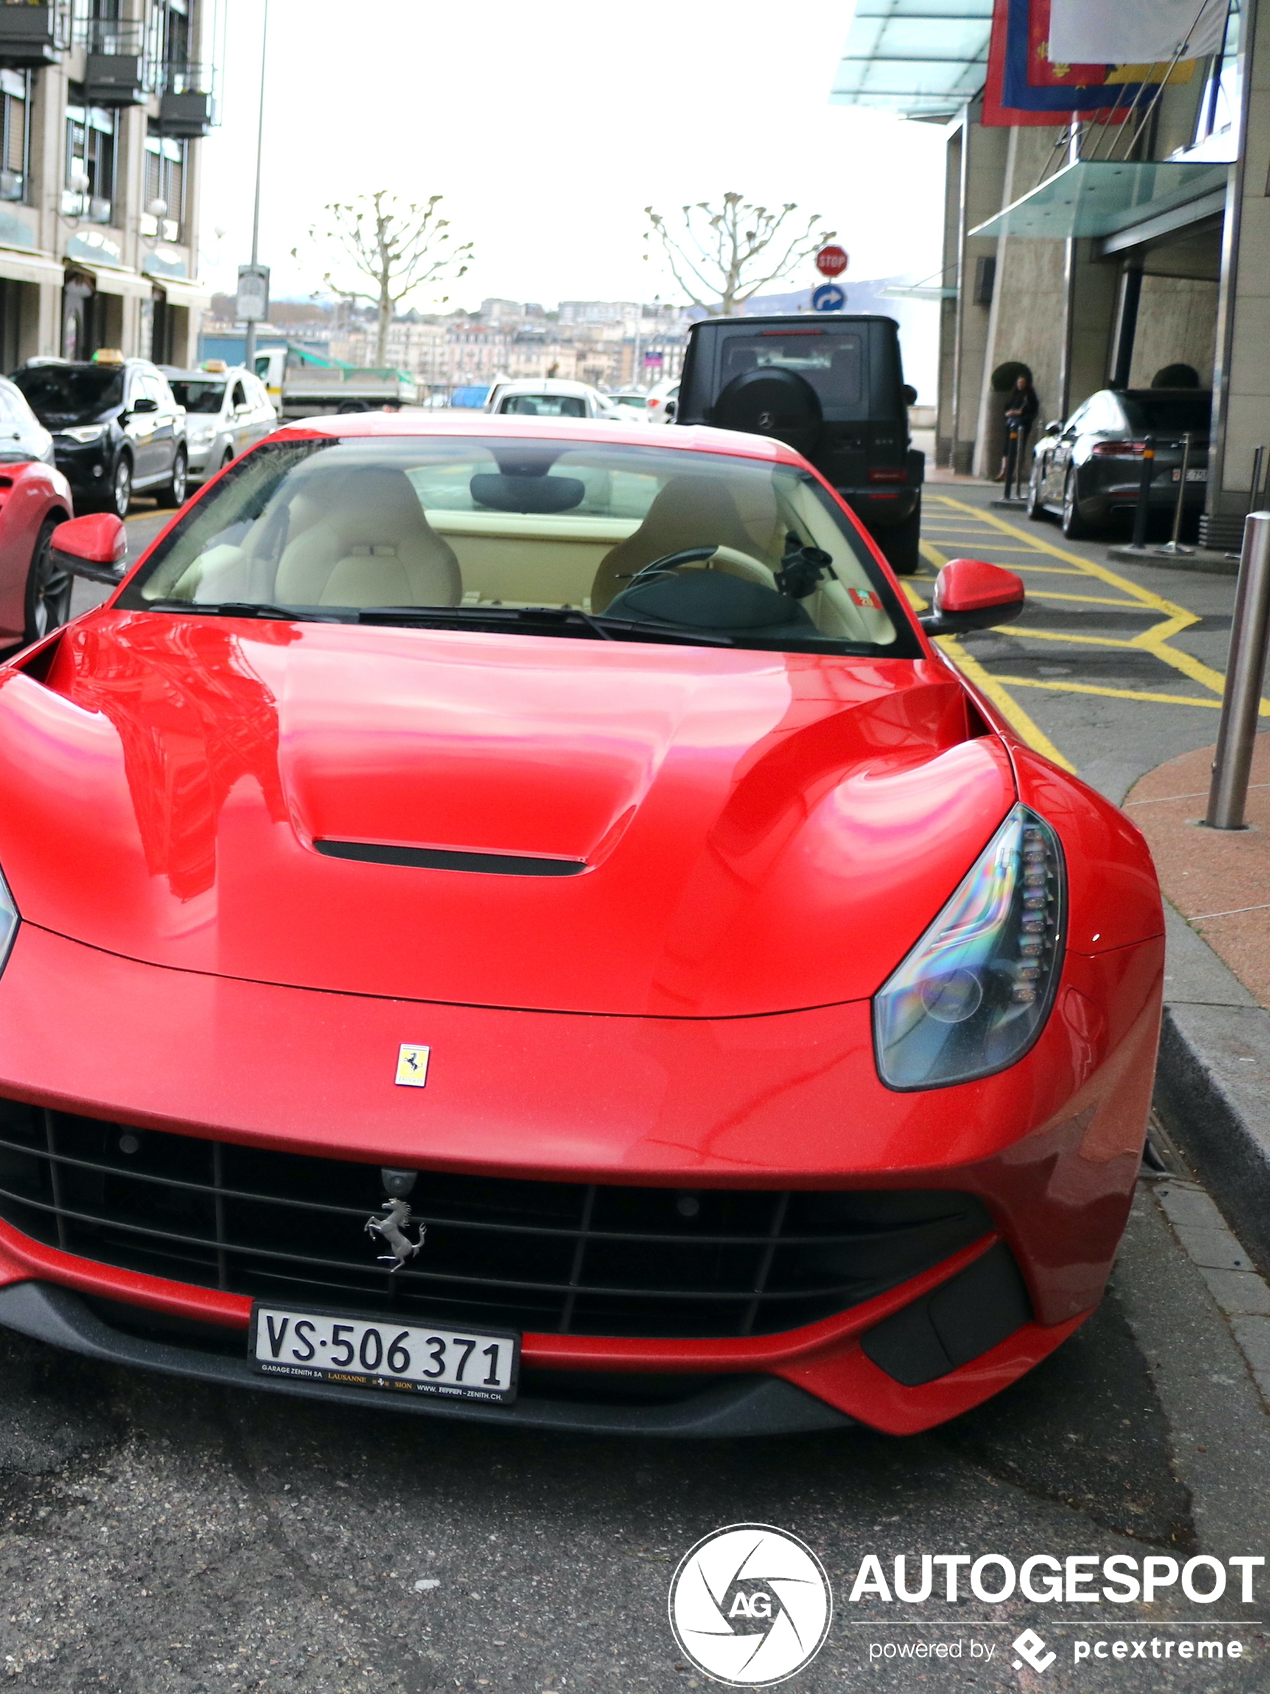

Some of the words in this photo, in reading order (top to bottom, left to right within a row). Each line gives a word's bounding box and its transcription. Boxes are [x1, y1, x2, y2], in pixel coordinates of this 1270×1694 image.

[818, 255, 846, 268] STOP
[422, 1336, 501, 1386] 371
[261, 1364, 290, 1374] GARAGE
[291, 1367, 312, 1376] ZENITH
[327, 1373, 366, 1383] LAUSANNE
